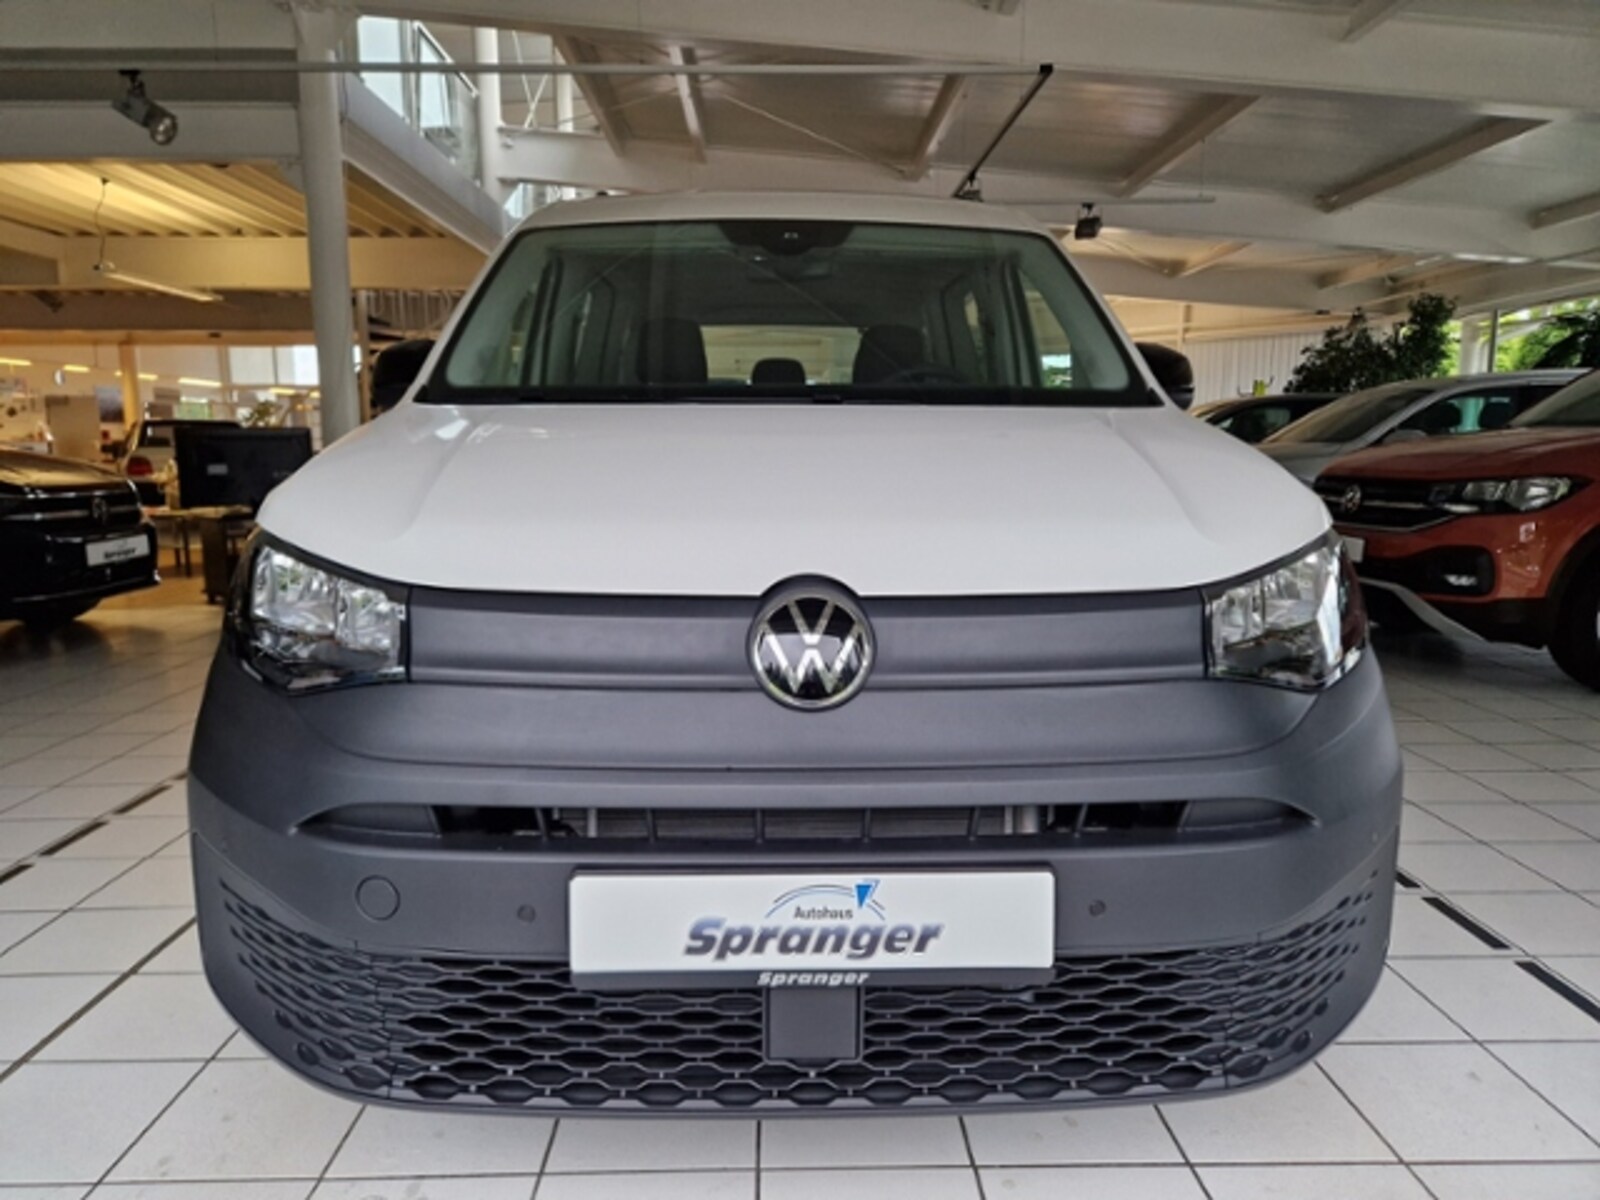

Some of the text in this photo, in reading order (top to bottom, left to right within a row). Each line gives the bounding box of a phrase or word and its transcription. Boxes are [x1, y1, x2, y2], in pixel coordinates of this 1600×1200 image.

[793, 906, 853, 920] Autohaus
[684, 917, 943, 961] Spranger
[757, 971, 869, 987] Spranger
